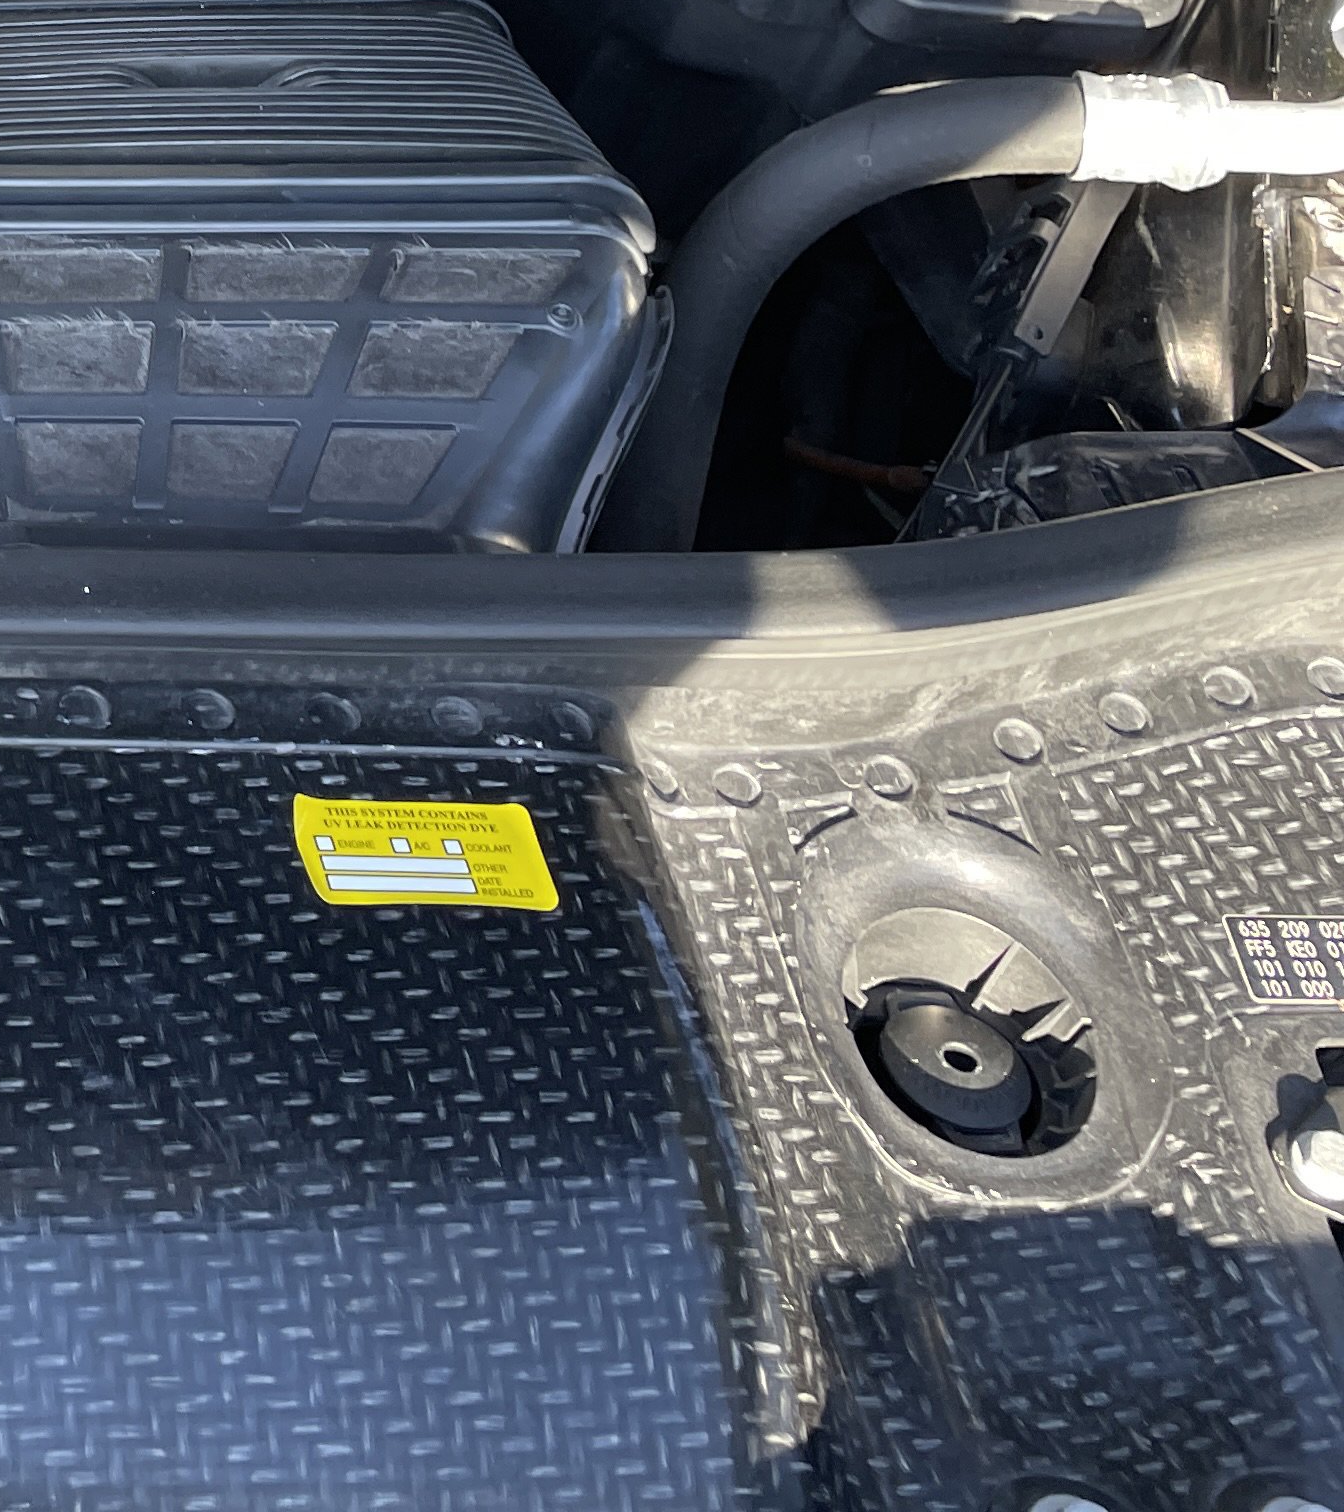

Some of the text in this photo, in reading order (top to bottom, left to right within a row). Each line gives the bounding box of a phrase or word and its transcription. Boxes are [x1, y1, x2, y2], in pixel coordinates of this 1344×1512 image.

[325, 807, 489, 822] THIS SYSTEM CONTAINS
[323, 819, 499, 834] UV LEAK DETECTION DYE
[465, 843, 513, 854] COOLANT
[472, 863, 509, 874] OTHER
[477, 877, 503, 887] DATE
[481, 888, 535, 899] INSTALLED
[1238, 920, 1271, 938] 635
[1277, 920, 1310, 939] 209
[1253, 959, 1285, 977] 101
[1292, 960, 1327, 978] 010
[1261, 979, 1292, 997] 101
[1300, 979, 1335, 997] 000
